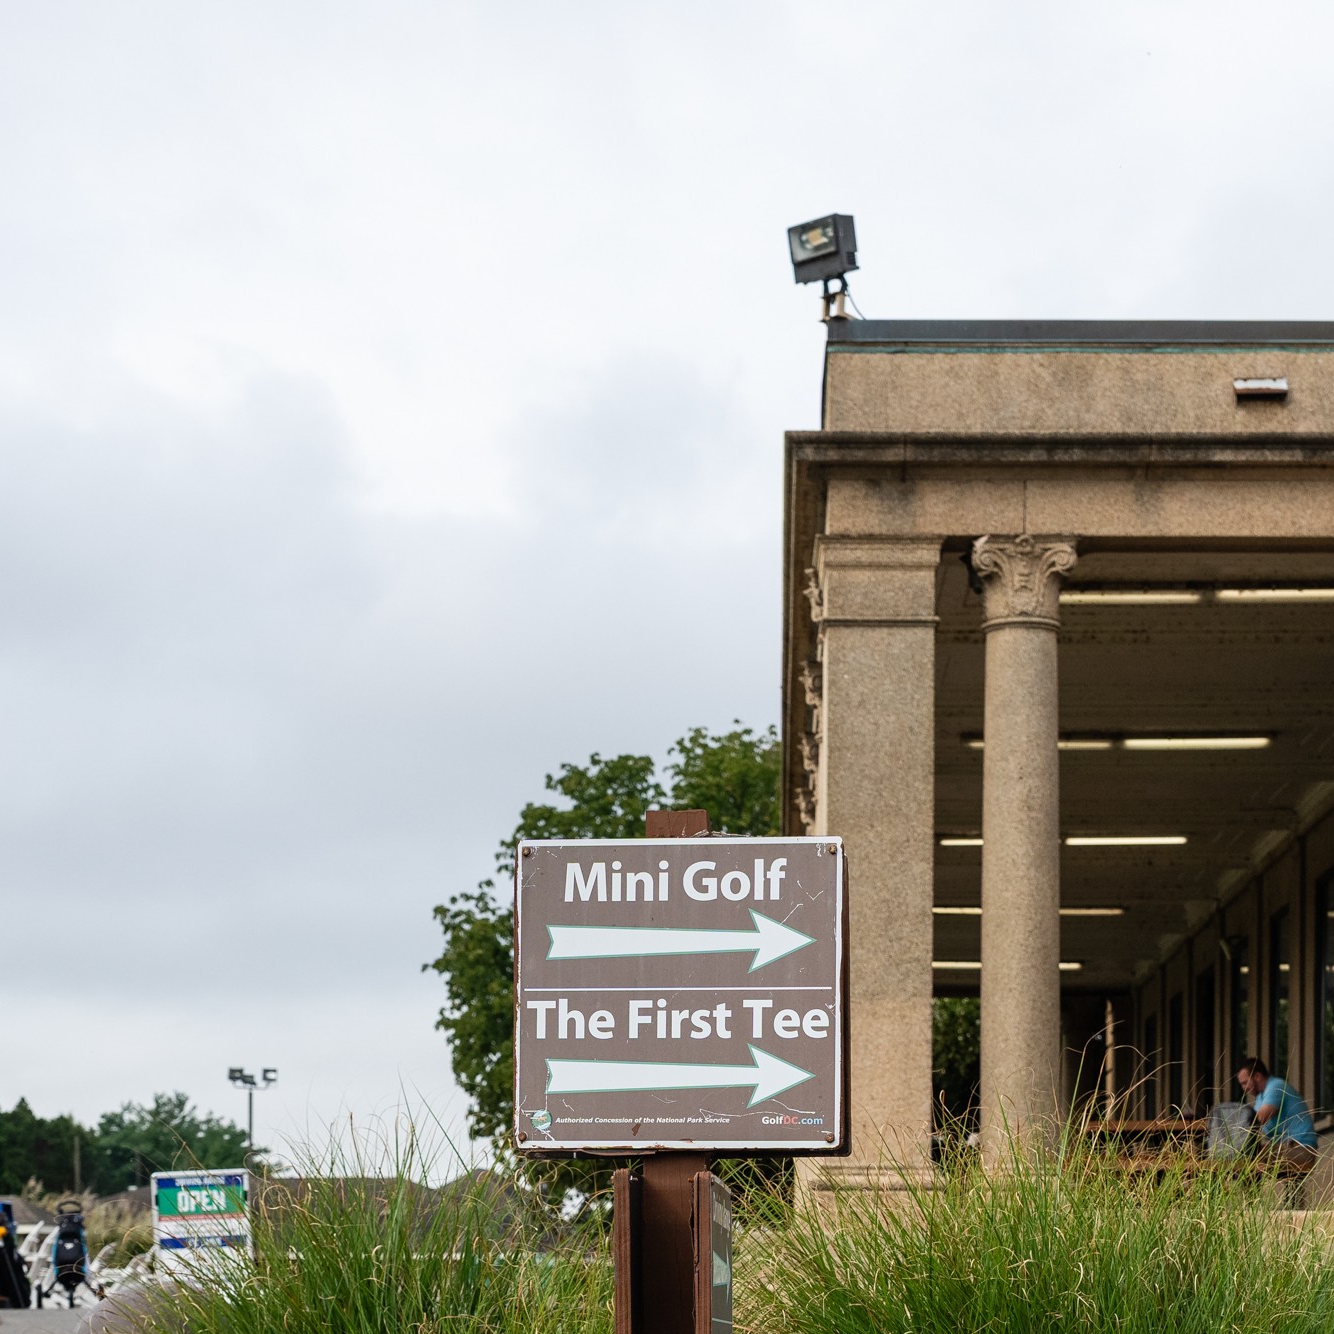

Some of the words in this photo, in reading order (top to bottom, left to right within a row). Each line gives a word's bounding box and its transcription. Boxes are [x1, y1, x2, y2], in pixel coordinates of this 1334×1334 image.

[565, 860, 668, 902] Mini
[683, 858, 787, 901] Golf
[527, 999, 615, 1040] The
[629, 998, 732, 1039] First
[743, 1000, 829, 1038] Tee
[556, 1116, 593, 1124] Authorized
[595, 1116, 632, 1124] Concession
[635, 1116, 641, 1124] of
[643, 1116, 654, 1124] the
[656, 1116, 685, 1124] National
[687, 1116, 703, 1124] Park
[704, 1116, 730, 1124] Service
[762, 1116, 823, 1125] GolfDC.com
[177, 1190, 226, 1212] OPEN
